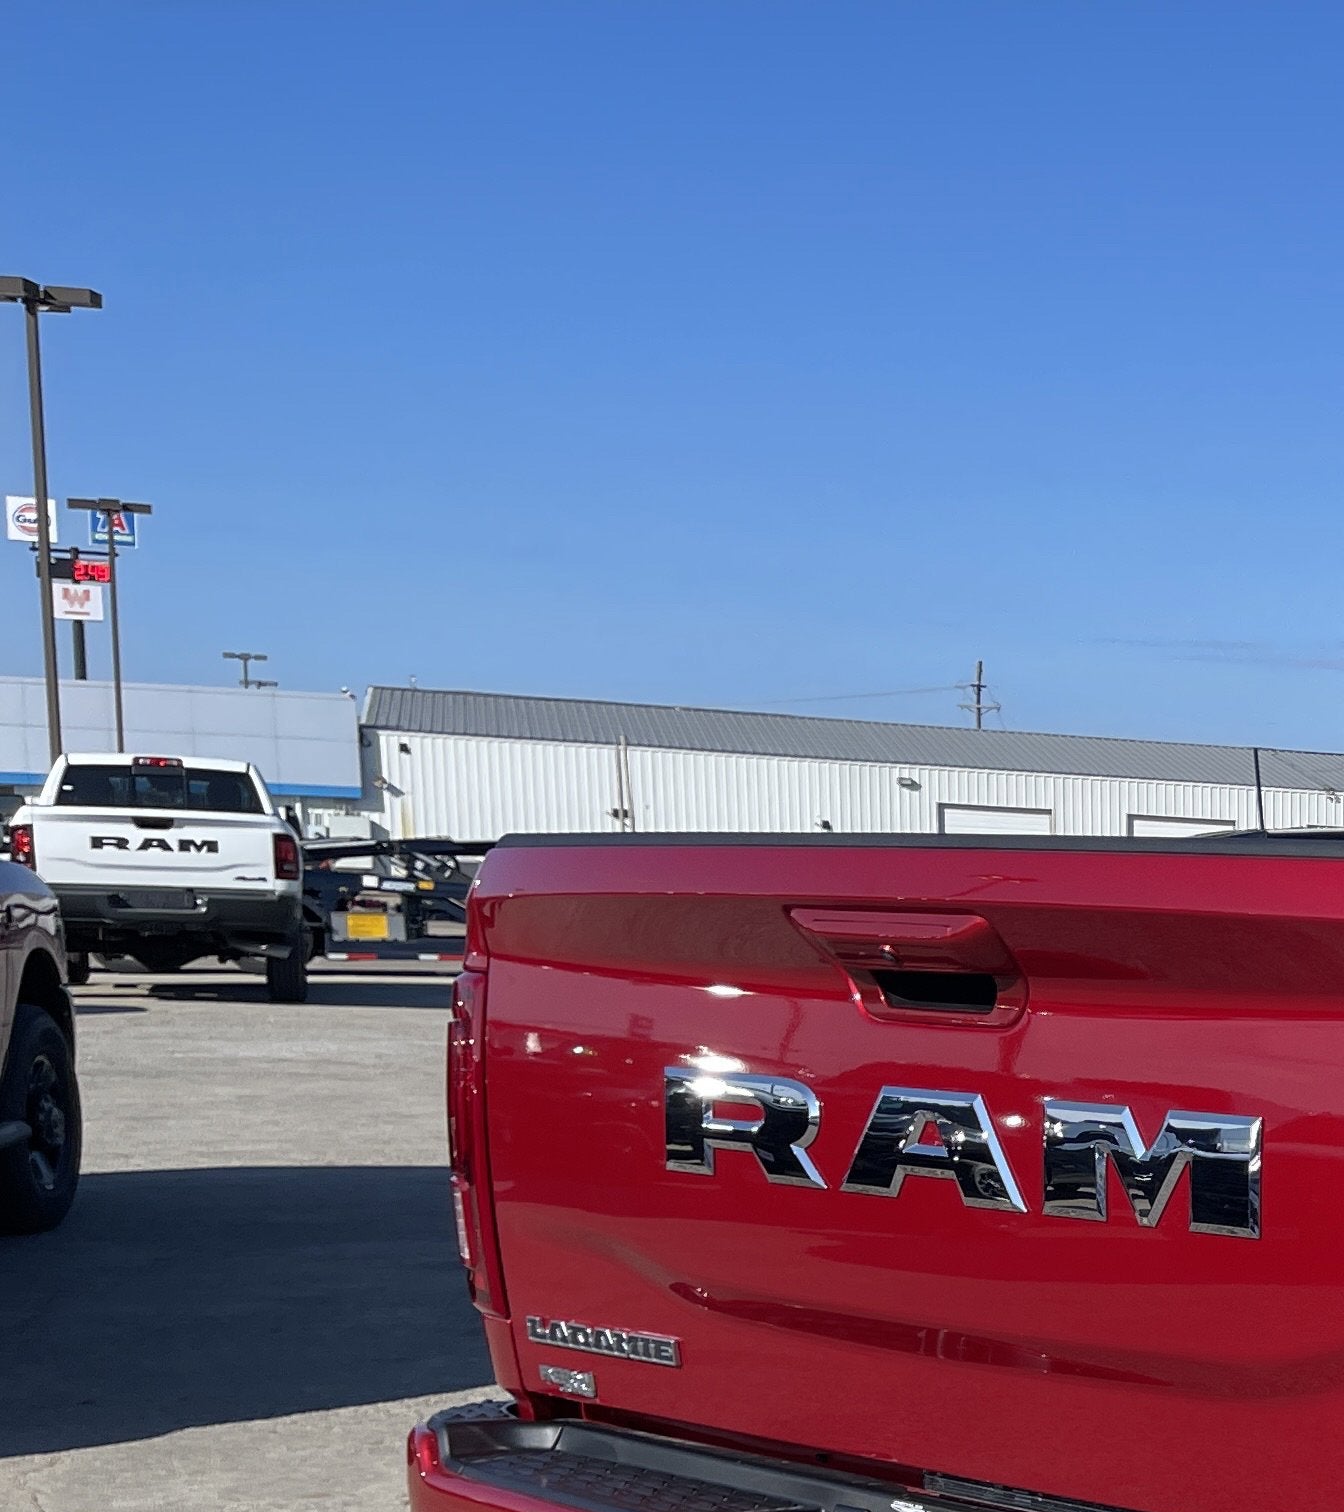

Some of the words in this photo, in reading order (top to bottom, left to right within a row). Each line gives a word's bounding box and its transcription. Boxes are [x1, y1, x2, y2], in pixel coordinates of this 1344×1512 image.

[89, 835, 220, 854] RAM
[664, 1066, 1263, 1239] RAM
[526, 1316, 681, 1367] LARAMIE
